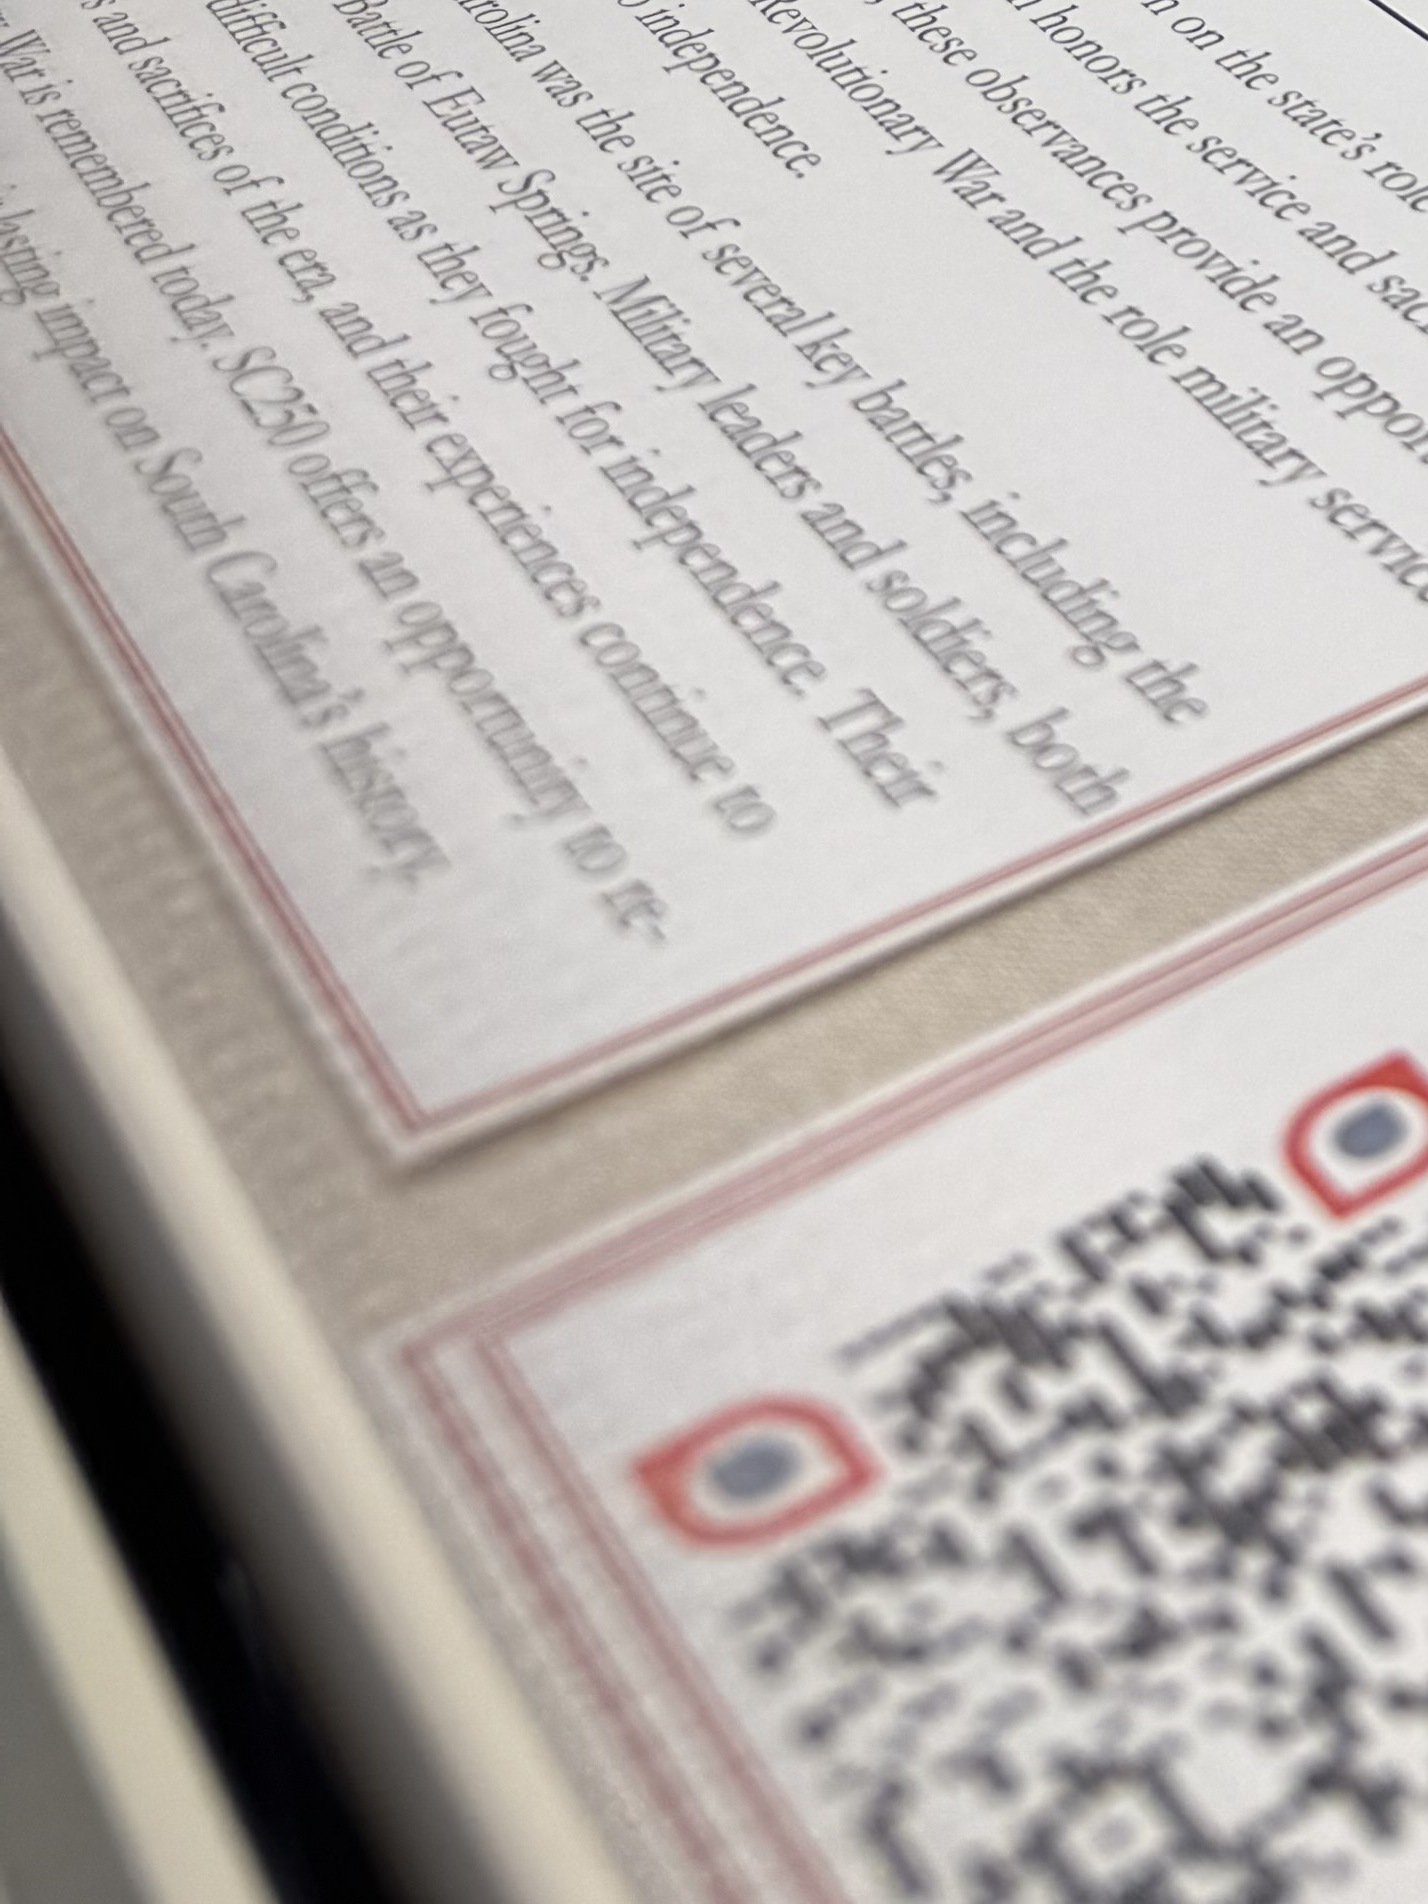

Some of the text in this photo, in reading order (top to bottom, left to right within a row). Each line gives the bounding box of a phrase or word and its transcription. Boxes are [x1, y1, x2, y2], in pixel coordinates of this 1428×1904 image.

[632, 1, 823, 181] independence.
[889, 0, 980, 68] these
[963, 66, 1155, 213] observances
[1115, 208, 1282, 315] provide
[1260, 312, 1327, 358] an
[1027, 2, 1149, 97] honors
[1132, 92, 1201, 138] the
[1183, 134, 1313, 223] service
[1294, 220, 1401, 277] and
[1169, 14, 1227, 53] on
[1212, 48, 1281, 93] the
[1265, 88, 1385, 163] state’s
[930, 146, 1009, 212] War
[984, 207, 1086, 262] and
[1046, 256, 1121, 307] the
[1099, 303, 1194, 367] role
[1167, 364, 1329, 489] military
